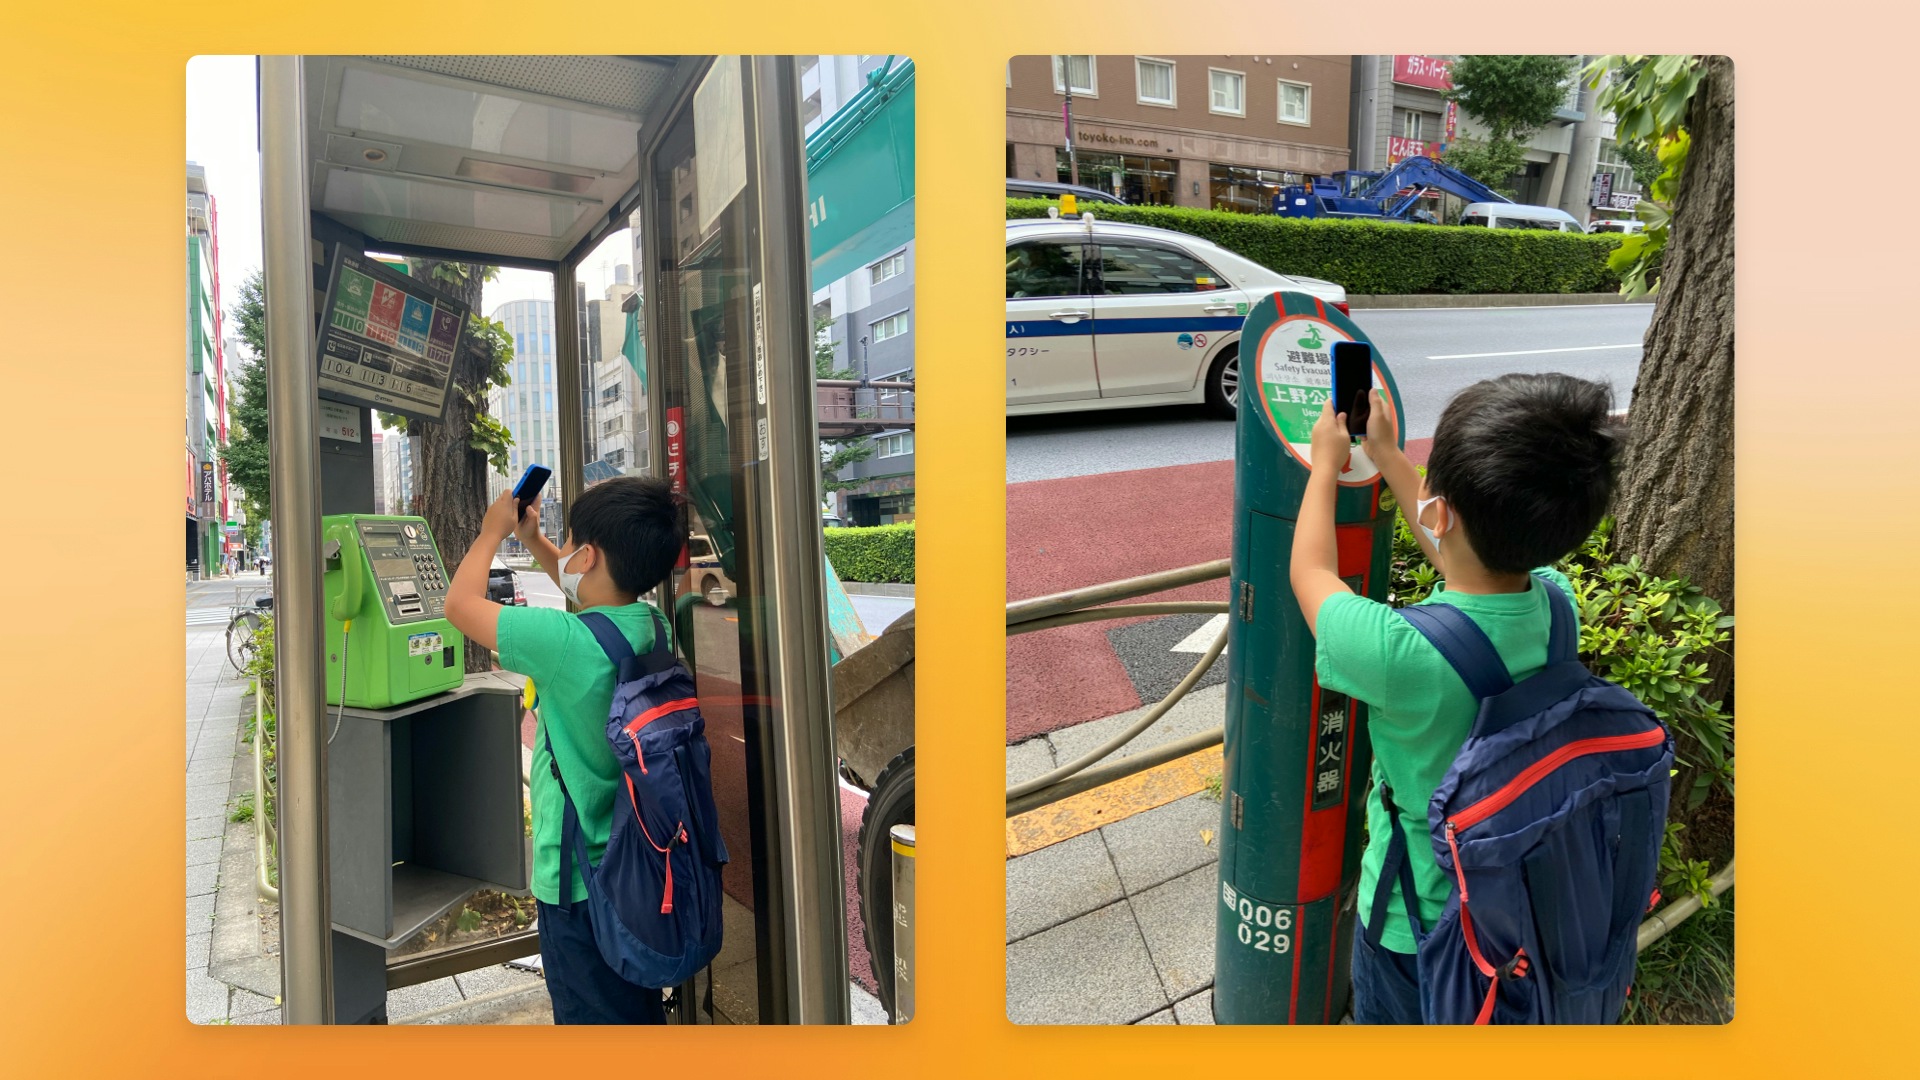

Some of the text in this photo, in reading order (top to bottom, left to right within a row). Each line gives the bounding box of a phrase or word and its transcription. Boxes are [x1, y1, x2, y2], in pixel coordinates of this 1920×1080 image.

[334, 313, 365, 332] 110
[1007, 347, 1050, 356] タクシー
[1287, 350, 1332, 366] 避難場
[327, 360, 352, 376] 104
[362, 370, 385, 386] 113
[1274, 363, 1332, 376] Safety Evacuat
[1317, 710, 1344, 793] 消火器
[1239, 898, 1292, 930] 006
[1238, 923, 1290, 954] 029
